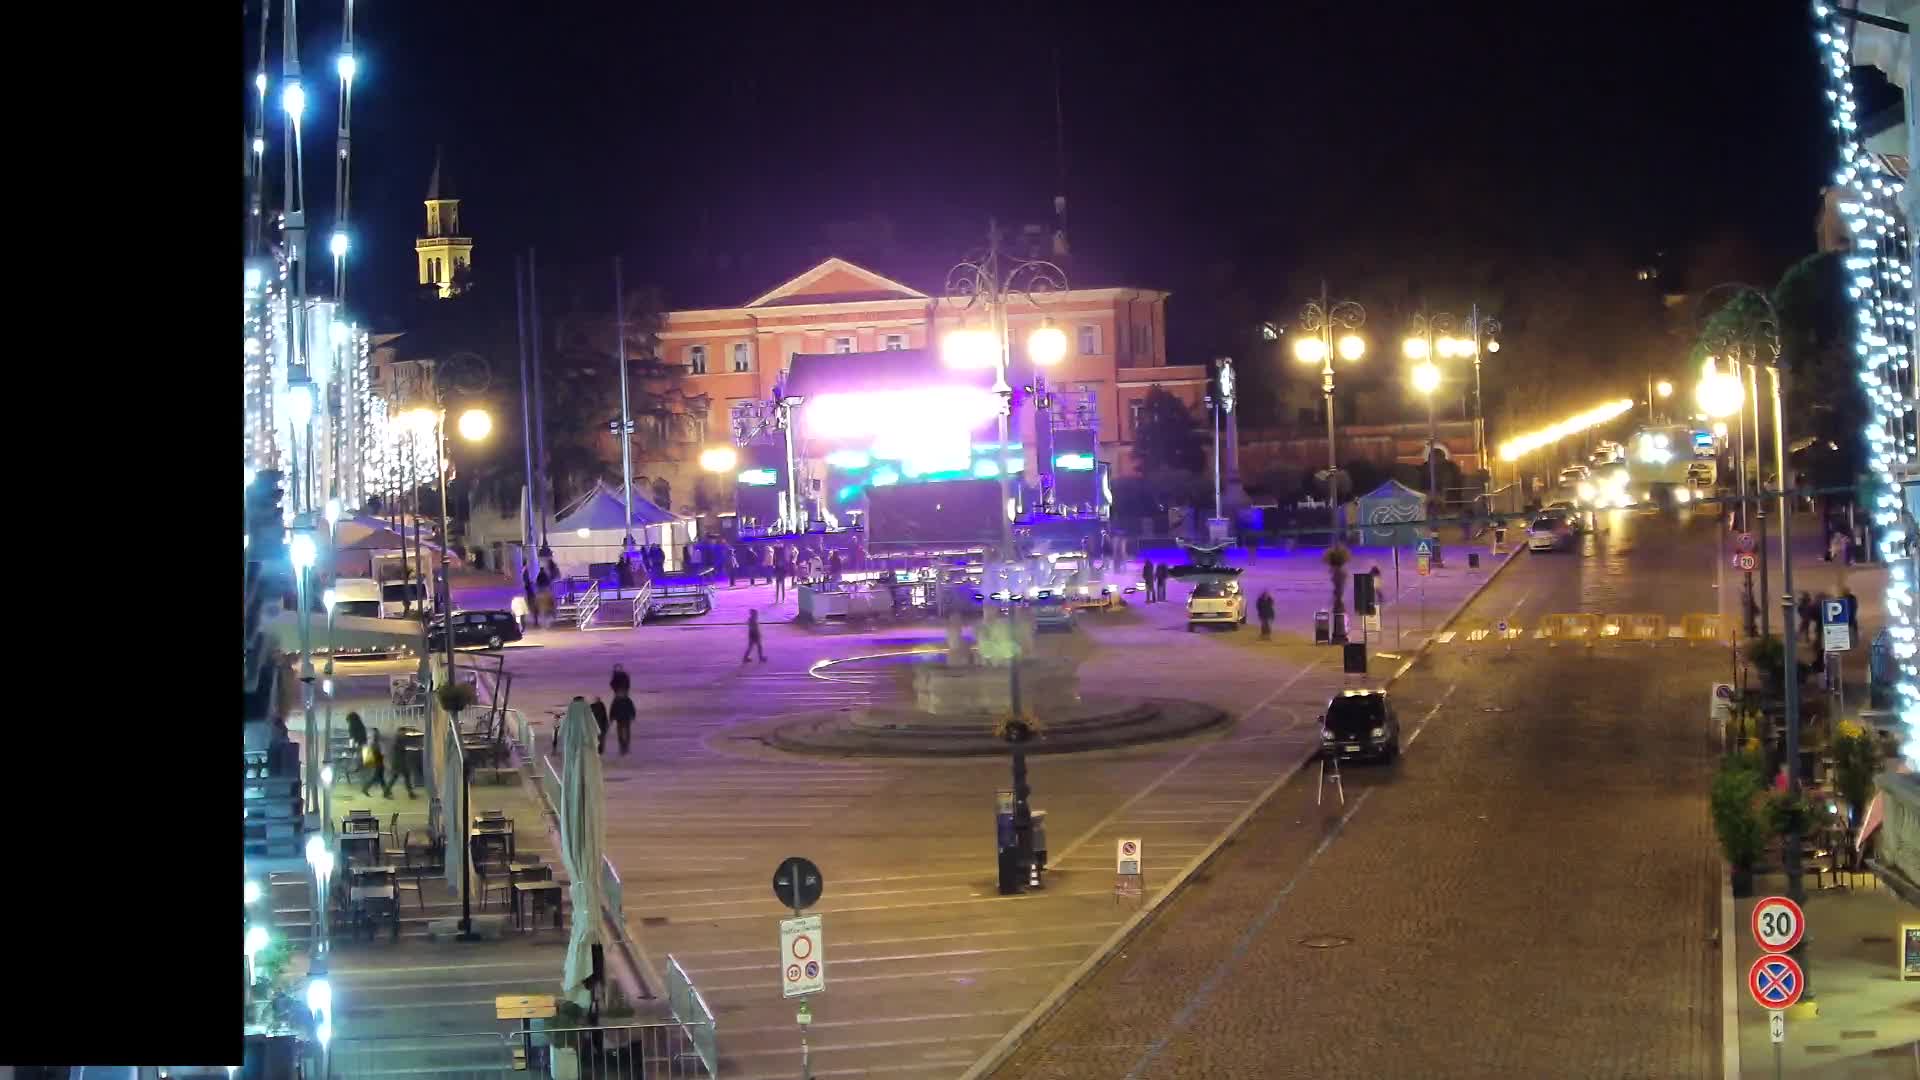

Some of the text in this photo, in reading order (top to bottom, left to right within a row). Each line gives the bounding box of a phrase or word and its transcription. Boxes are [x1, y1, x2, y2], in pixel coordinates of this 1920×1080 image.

[1743, 557, 1753, 568] 20
[1827, 602, 1843, 621] P
[1763, 912, 1791, 937] 30
